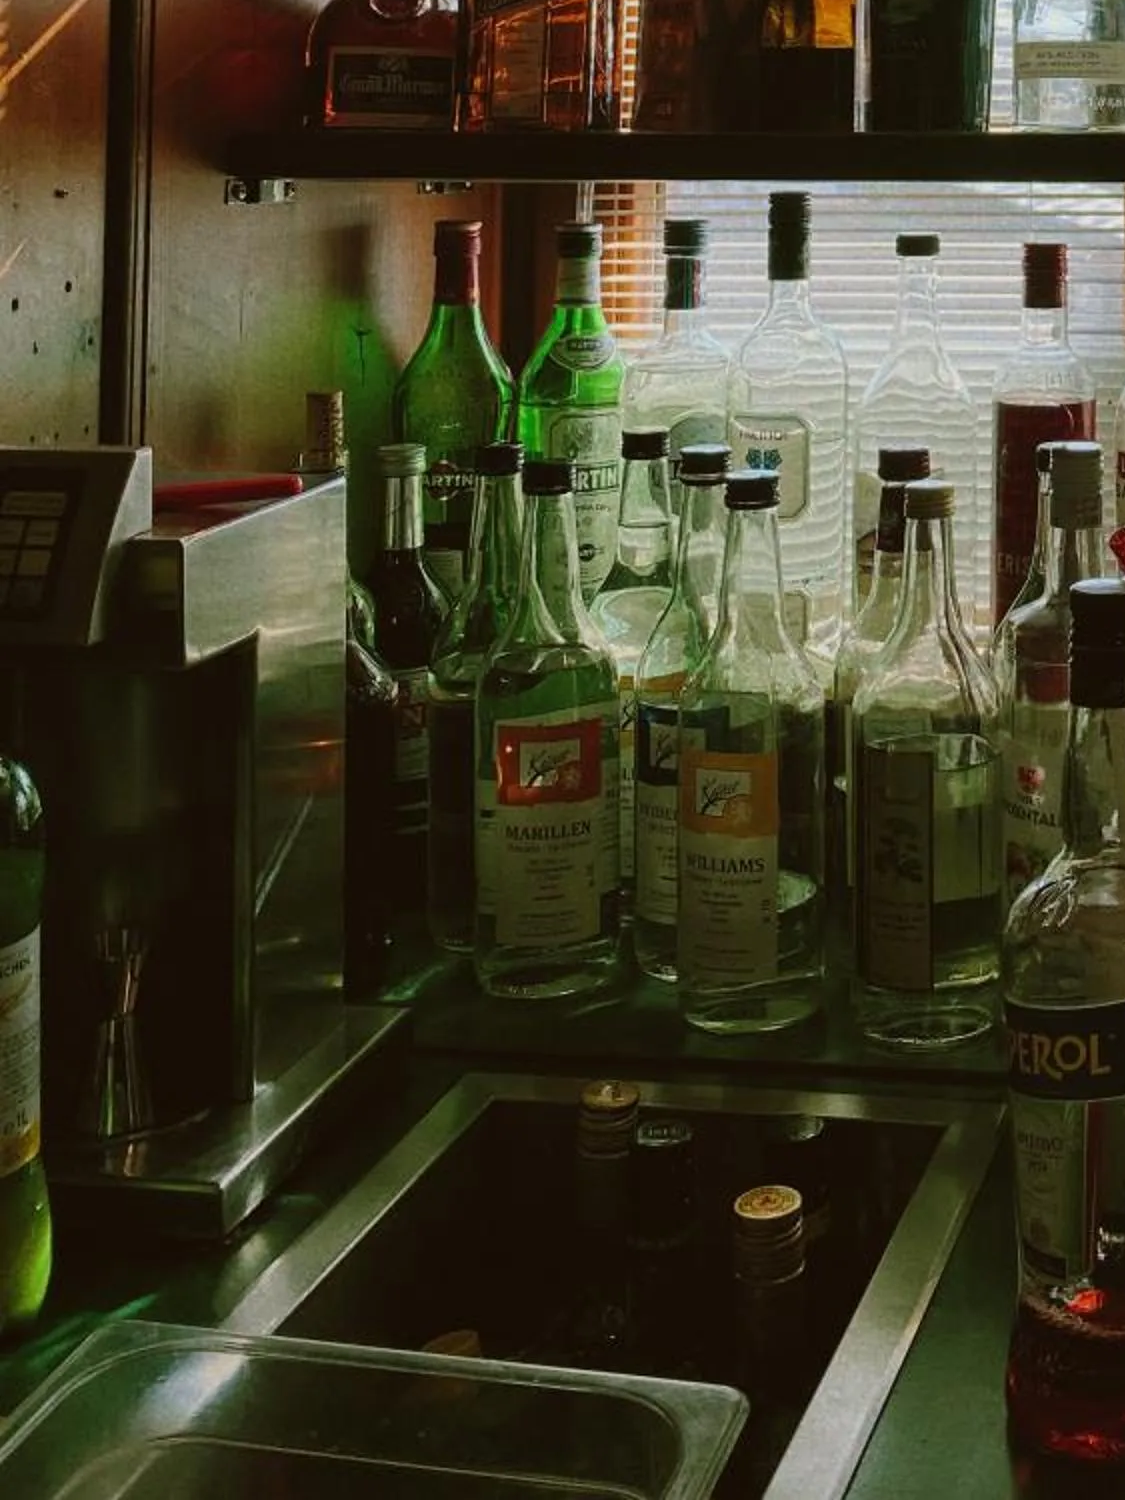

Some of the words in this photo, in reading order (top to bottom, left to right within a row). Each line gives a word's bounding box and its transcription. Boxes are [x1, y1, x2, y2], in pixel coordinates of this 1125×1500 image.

[505, 819, 592, 842] MARILLEN
[685, 853, 765, 874] WILLIAMS
[1008, 1030, 1113, 1082] PEROL
